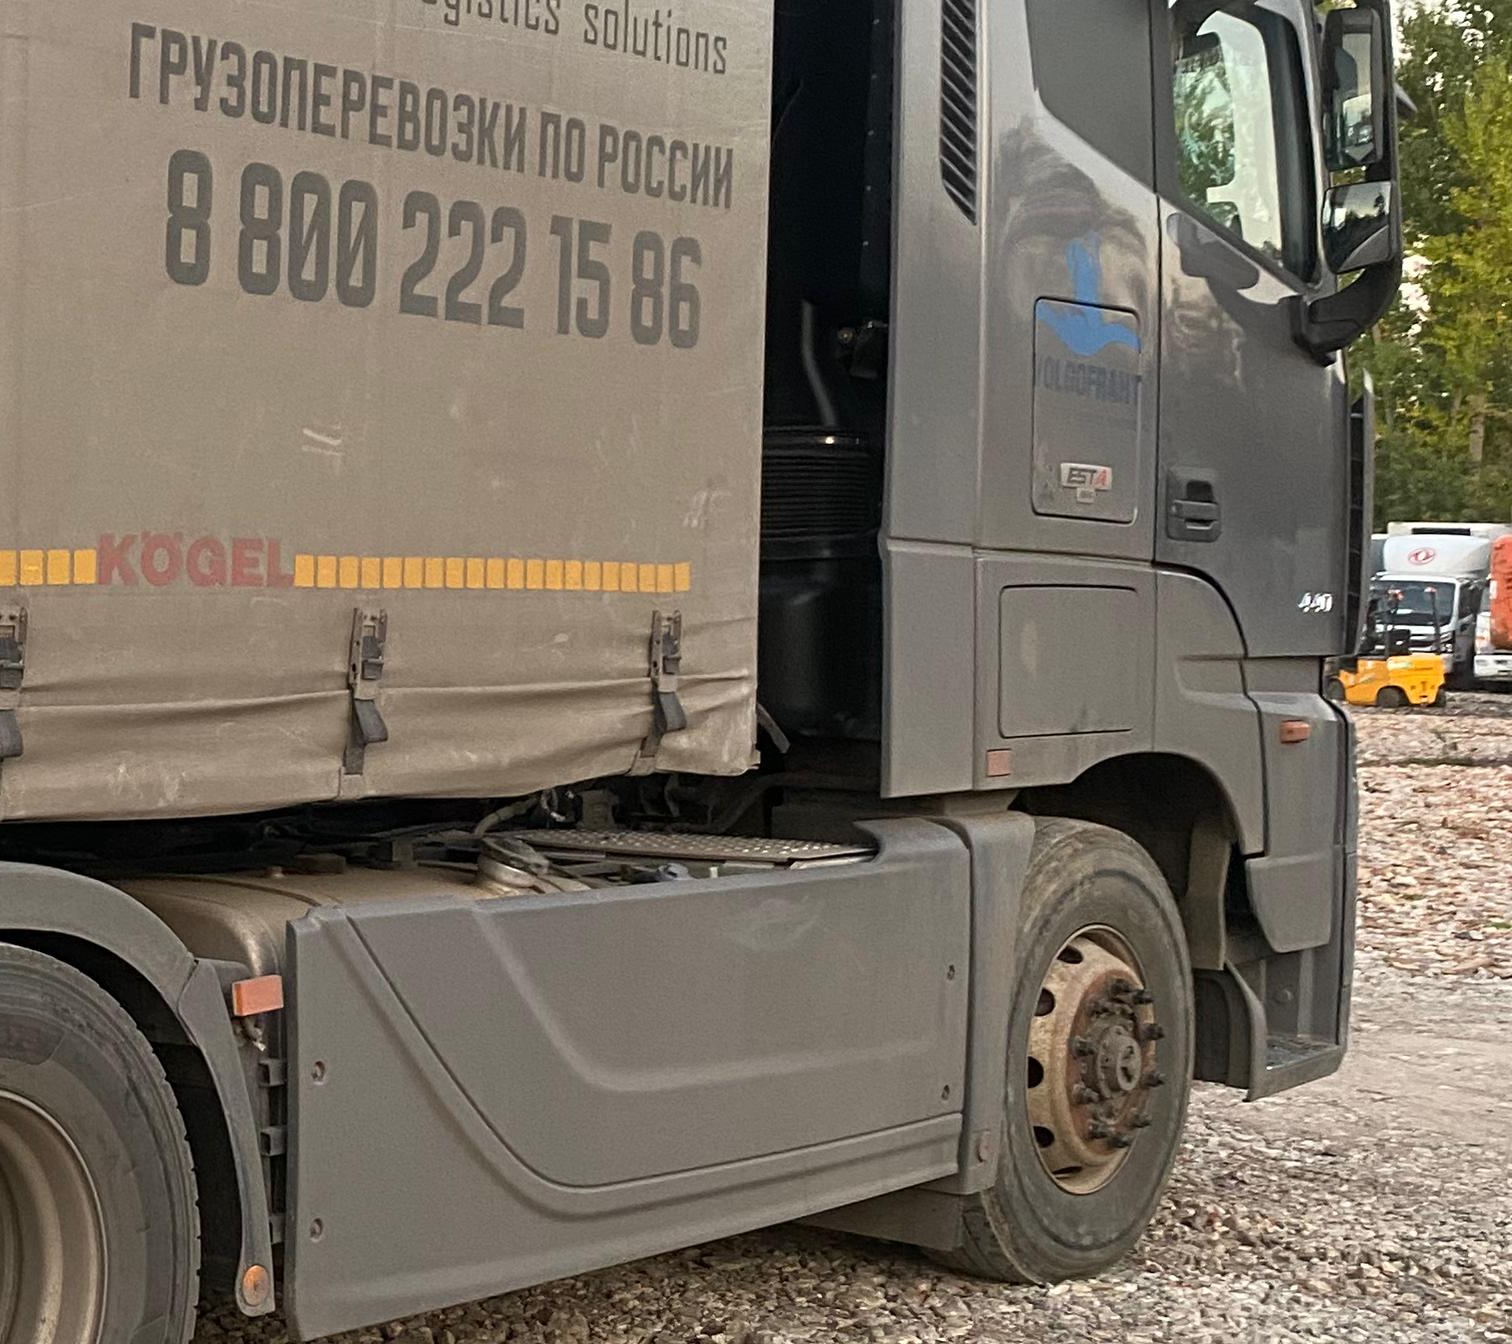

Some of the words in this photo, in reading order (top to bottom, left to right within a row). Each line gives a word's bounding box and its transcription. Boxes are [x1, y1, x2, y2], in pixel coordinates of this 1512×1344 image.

[129, 22, 527, 173] ГРУЗОПЕРЕВОЗКИ
[538, 112, 585, 183] ПО
[597, 123, 733, 208] РОССИИ
[166, 149, 212, 286] 8
[238, 162, 378, 307] 800
[399, 190, 526, 329] 222
[550, 215, 611, 339] 15
[631, 230, 702, 348] 86
[98, 531, 294, 588] KÖGEL
